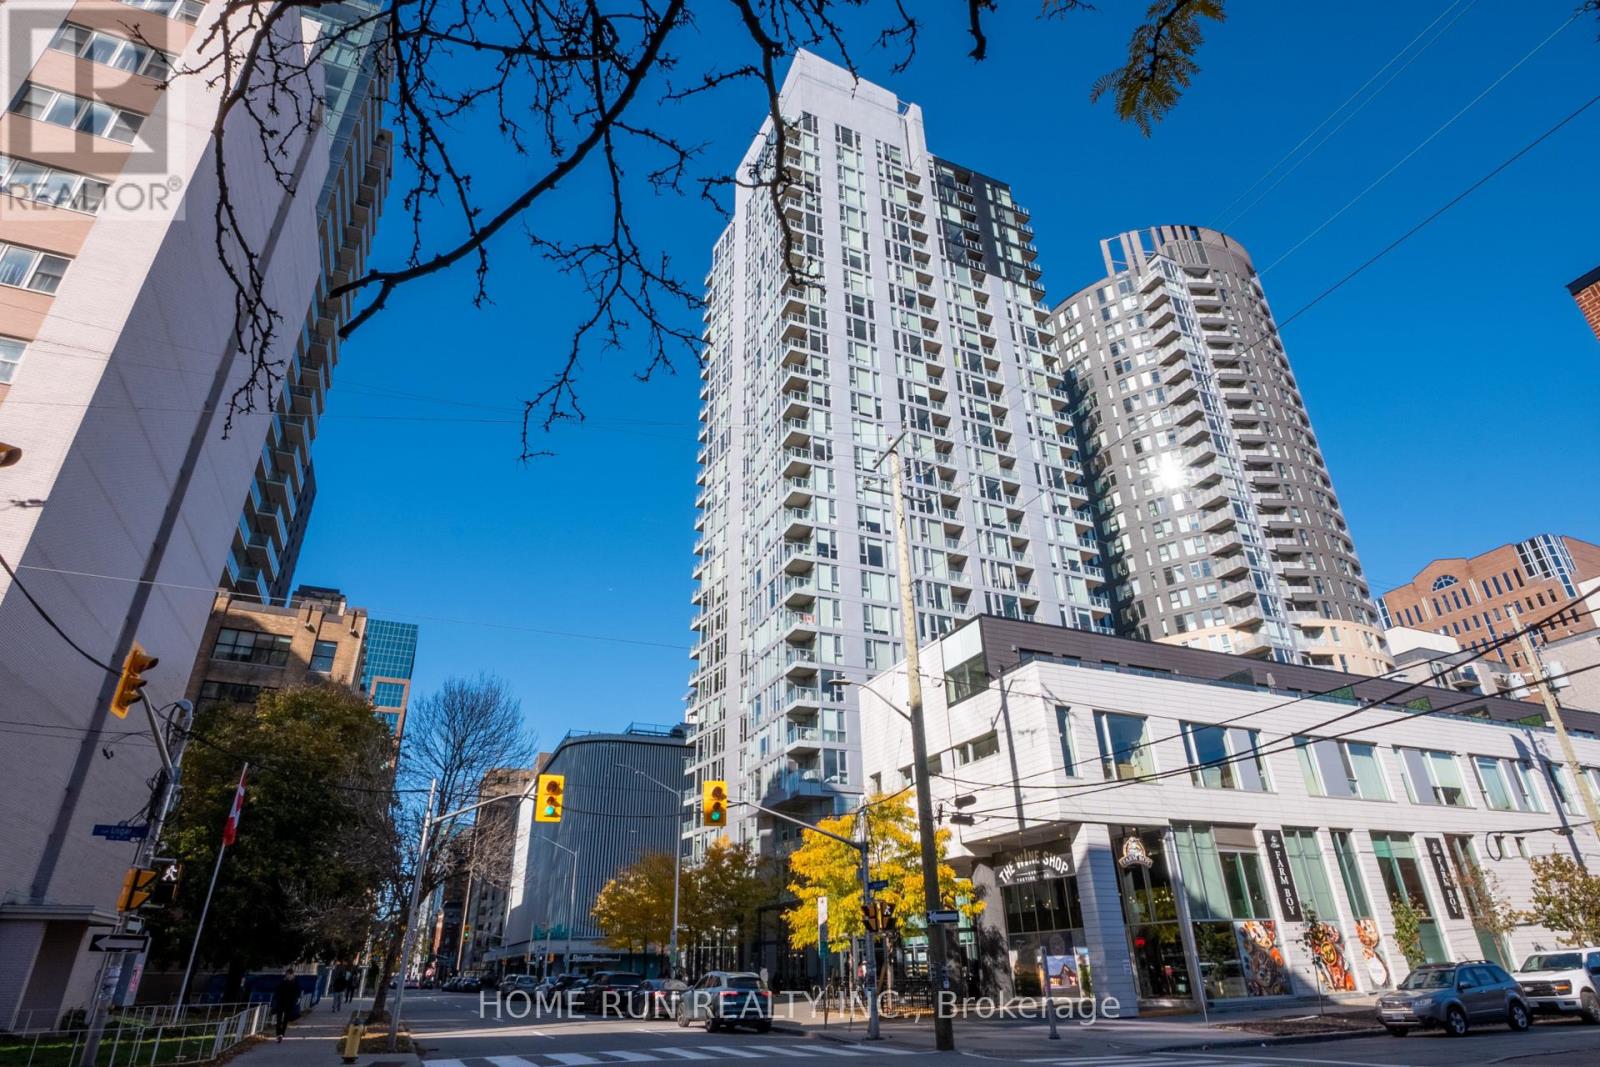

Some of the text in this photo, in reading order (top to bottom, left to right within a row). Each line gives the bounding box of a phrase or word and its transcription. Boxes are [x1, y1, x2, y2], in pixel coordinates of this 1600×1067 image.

[999, 848, 1069, 884] THE WINE SHOP
[1275, 850, 1296, 916] FARM BOY
[1436, 855, 1458, 914] FARM BOY
